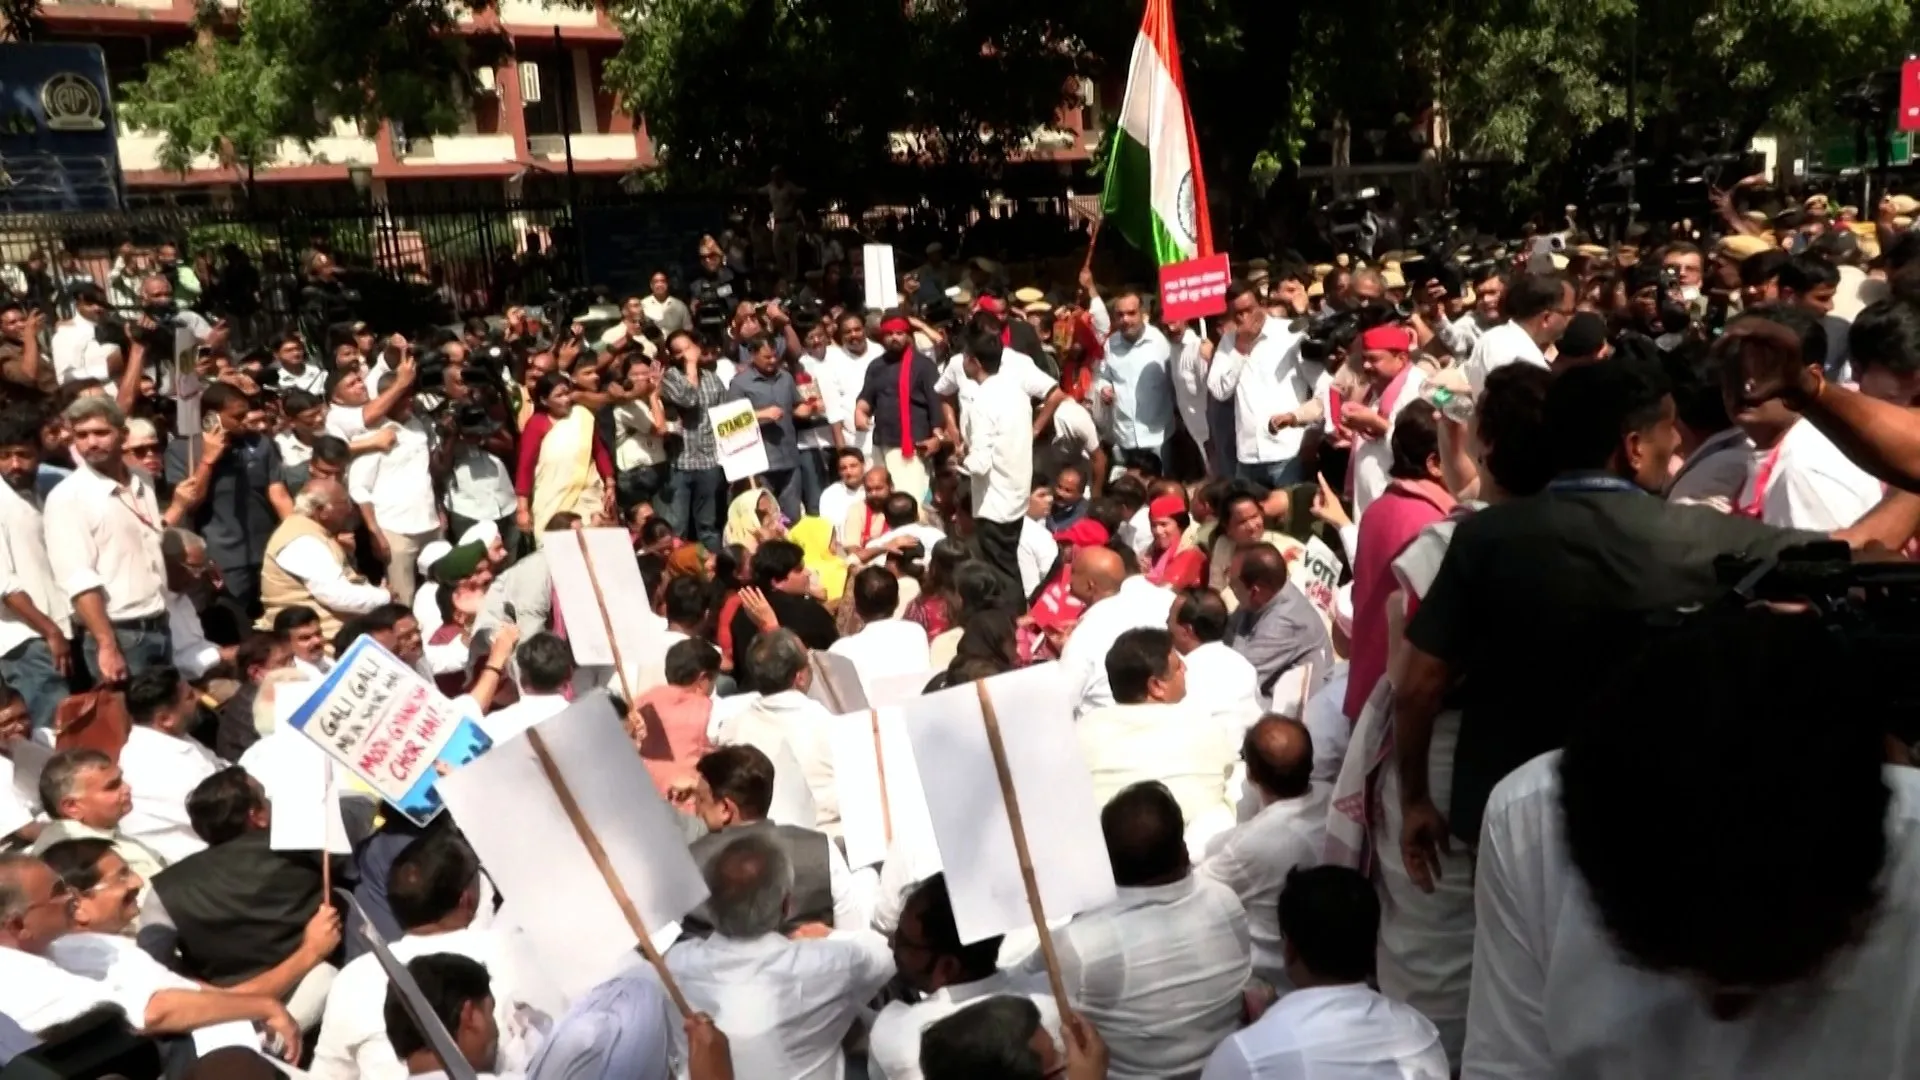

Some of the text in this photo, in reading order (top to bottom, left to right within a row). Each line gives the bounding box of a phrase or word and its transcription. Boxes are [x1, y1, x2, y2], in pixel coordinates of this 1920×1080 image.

[319, 658, 380, 737] GALI GALI
[388, 705, 444, 781] CHOR HAI!
